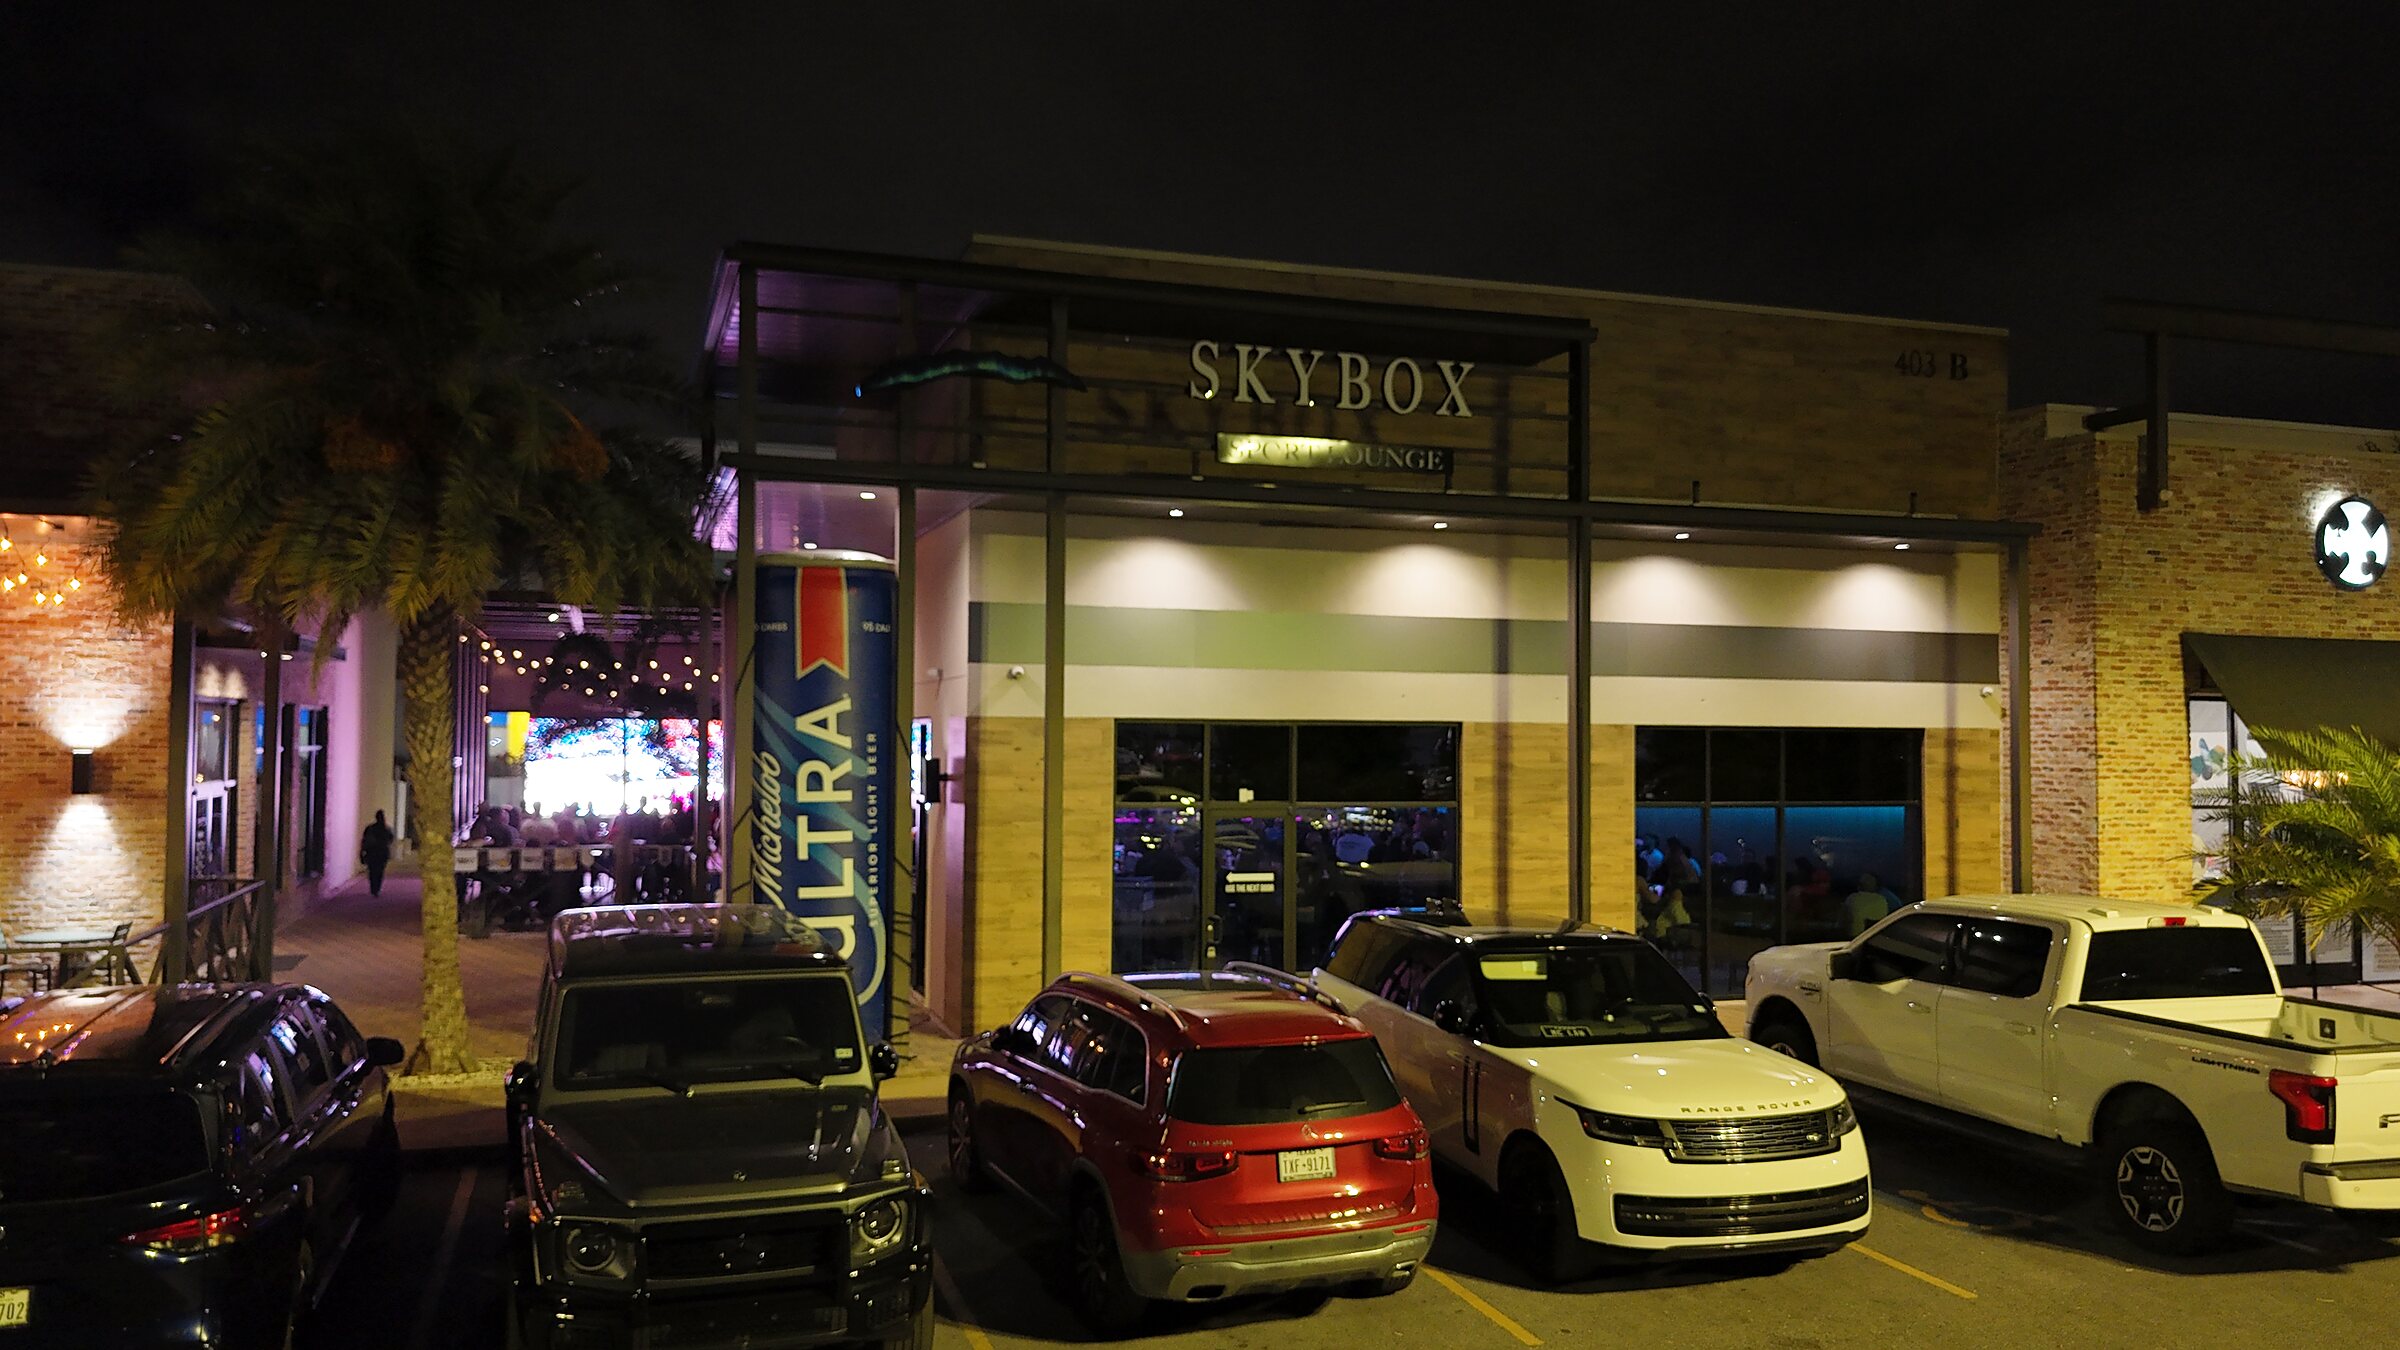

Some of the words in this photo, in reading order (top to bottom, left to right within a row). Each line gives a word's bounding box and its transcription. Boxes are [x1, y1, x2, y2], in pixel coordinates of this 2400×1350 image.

[1190, 340, 1475, 417] SKYBOX
[1894, 350, 1937, 378] 403
[1950, 353, 1969, 380] B
[1229, 439, 1314, 461] SPORT
[1328, 443, 1444, 471] LOUNGE
[865, 732, 877, 775] BEER
[751, 751, 786, 910] Michelob
[866, 784, 878, 834] LIGHT
[866, 841, 879, 928] SUPERIOR
[2191, 1056, 2261, 1075] LIGHTNING
[1680, 1104, 1745, 1114] RANGE
[1757, 1099, 1812, 1111] ROVER
